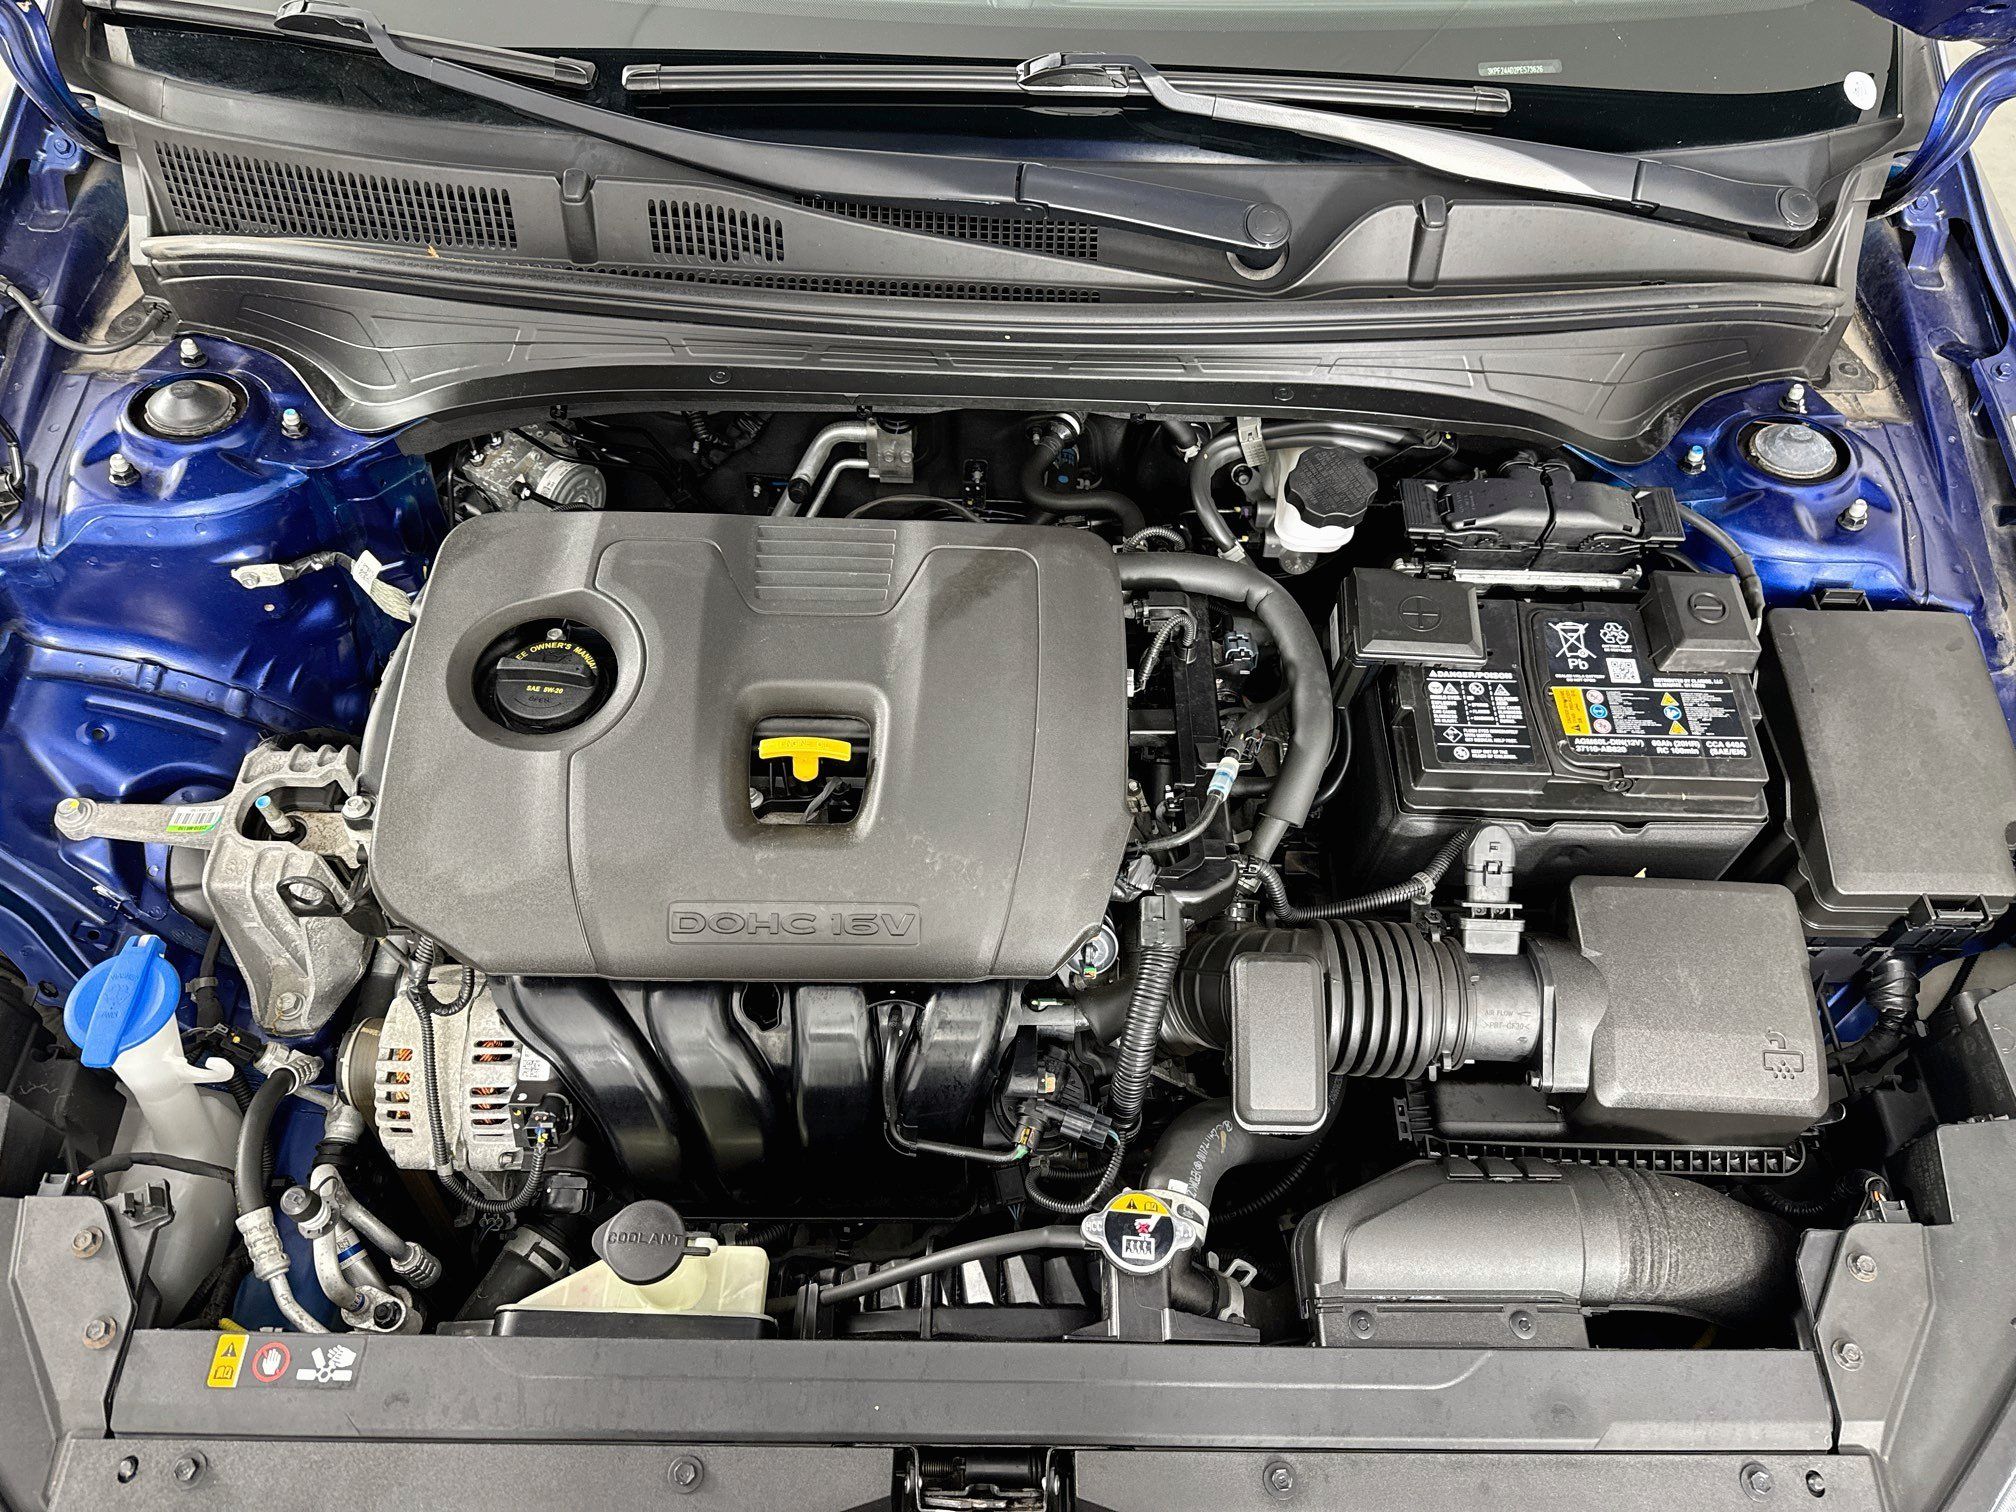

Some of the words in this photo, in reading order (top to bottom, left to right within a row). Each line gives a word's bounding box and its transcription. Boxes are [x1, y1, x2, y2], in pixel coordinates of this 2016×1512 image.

[530, 642, 572, 653] OWNER'S
[1568, 658, 1589, 670] Pb
[526, 684, 541, 693] SAE
[543, 686, 564, 694] 5W-20
[1706, 741, 1724, 749] CCA
[672, 911, 816, 935] DOHC
[830, 912, 916, 937] 16V
[607, 1231, 684, 1246] COOLANT
